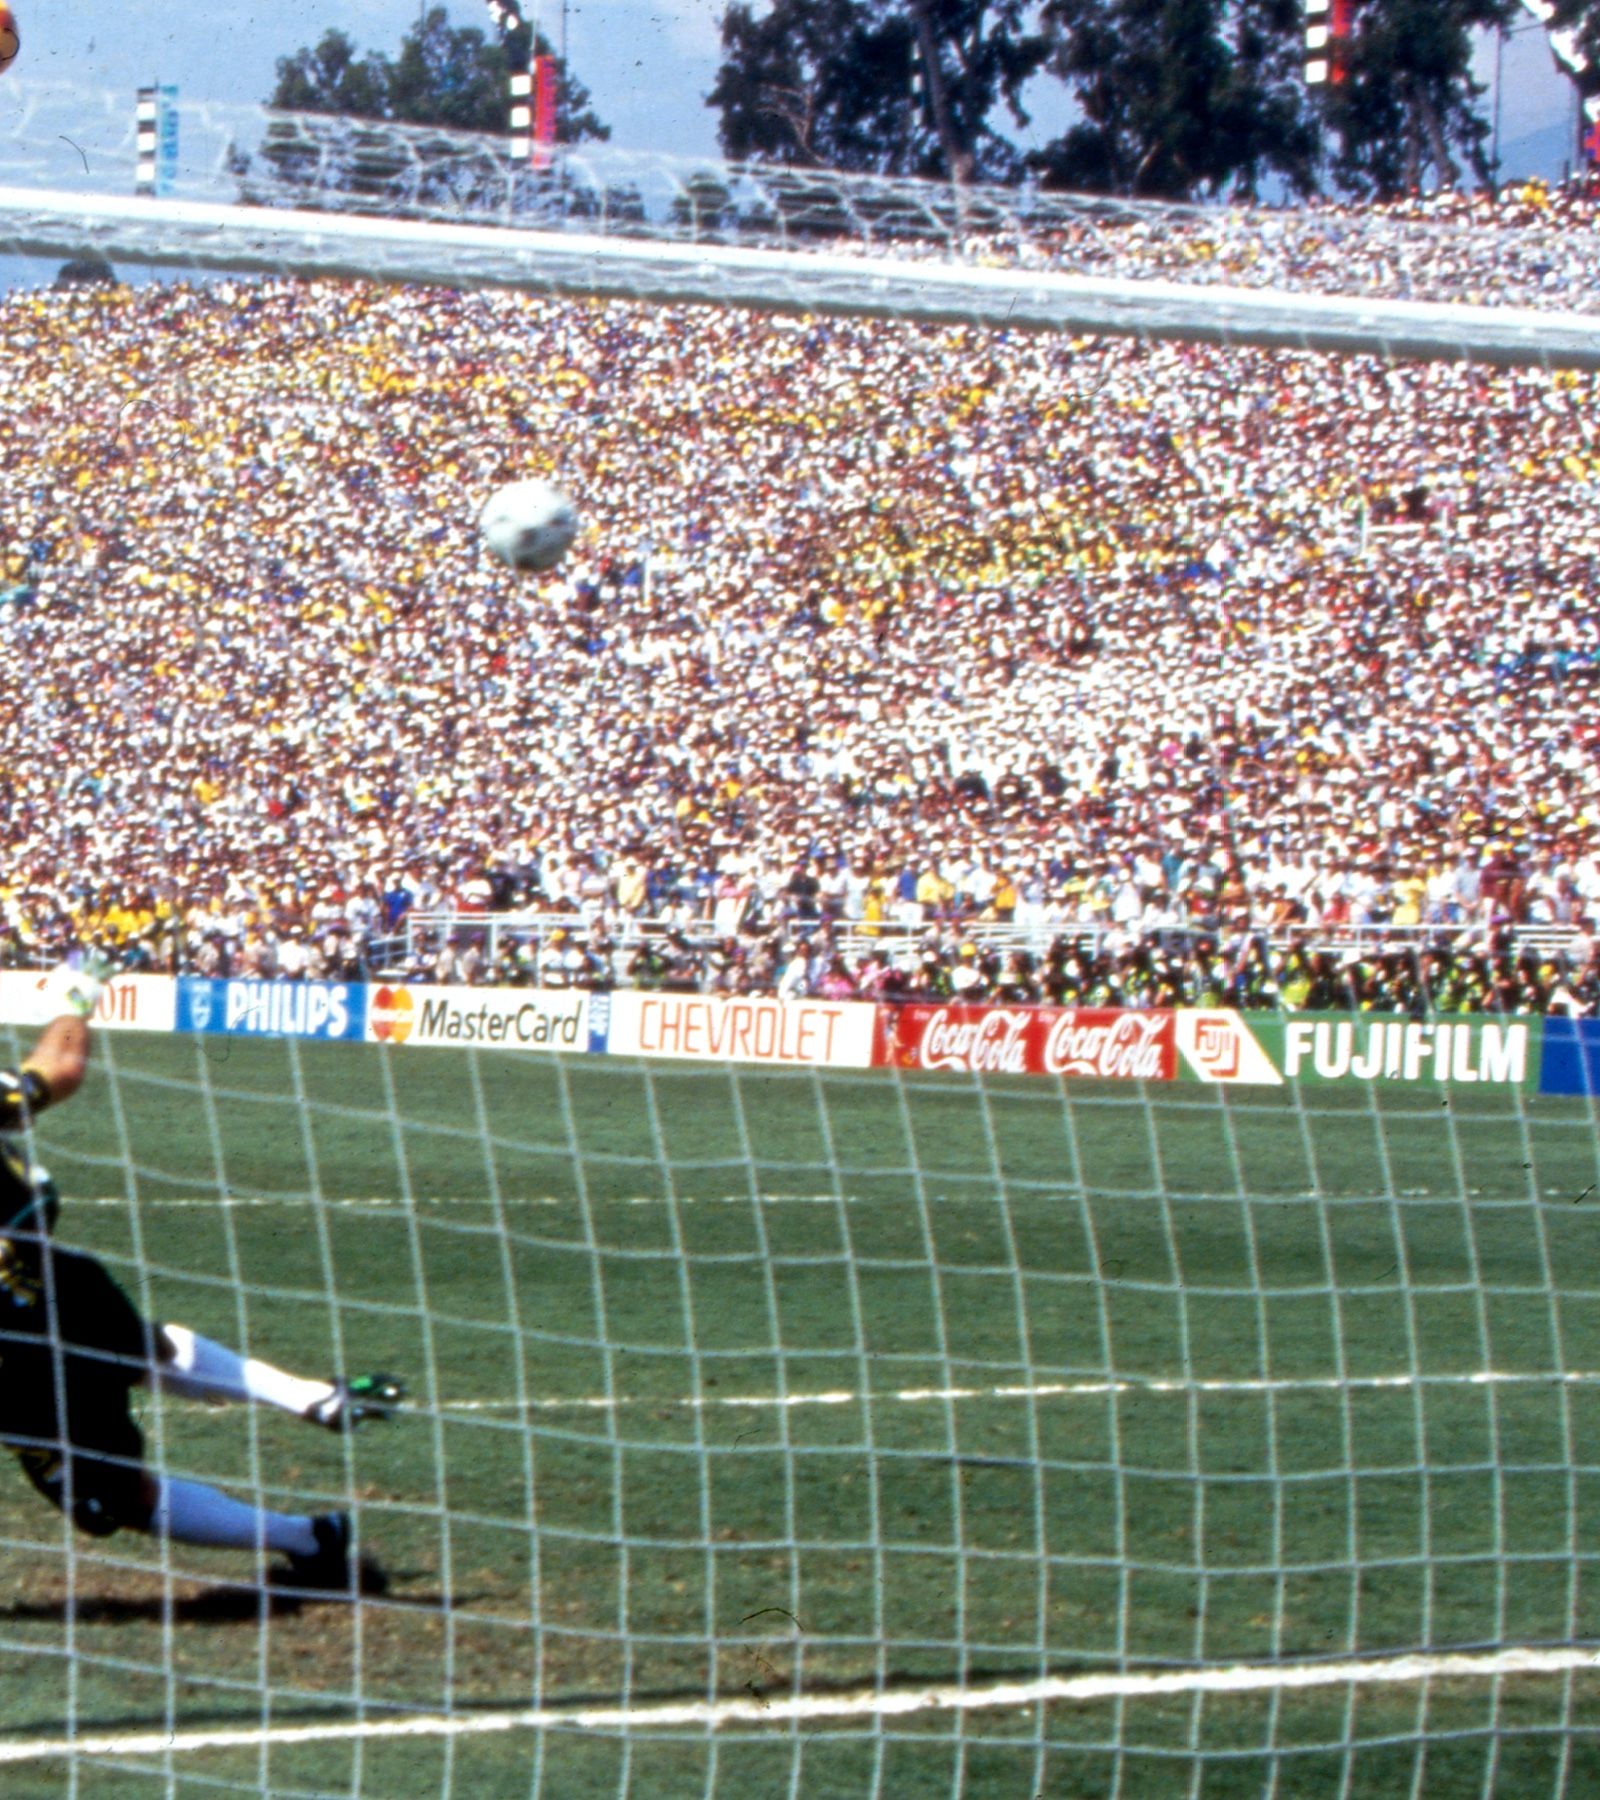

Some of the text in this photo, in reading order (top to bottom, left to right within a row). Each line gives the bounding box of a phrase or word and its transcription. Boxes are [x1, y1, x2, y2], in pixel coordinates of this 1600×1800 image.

[226, 981, 348, 1037] PHILIPS
[419, 998, 583, 1044] MasterCard
[639, 1000, 843, 1062] CHEVROLET
[1284, 1021, 1527, 1083] FUJIFILM
